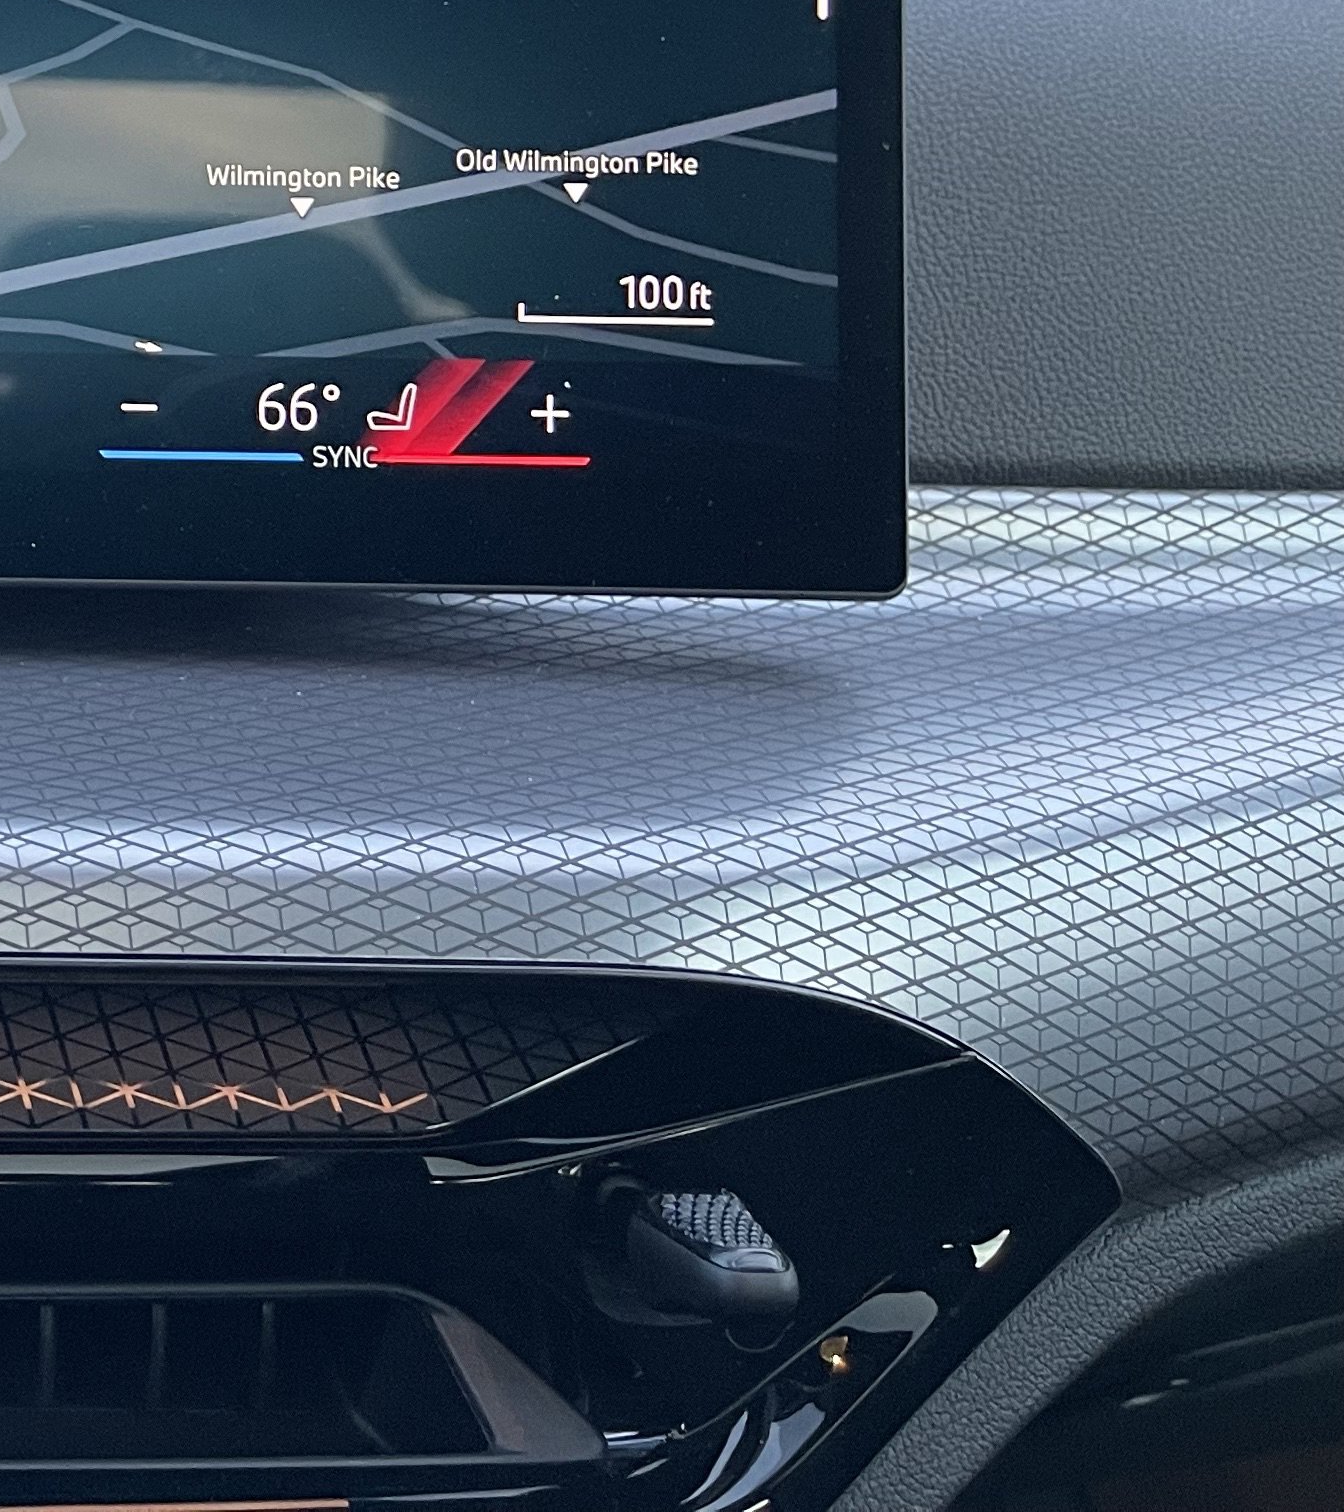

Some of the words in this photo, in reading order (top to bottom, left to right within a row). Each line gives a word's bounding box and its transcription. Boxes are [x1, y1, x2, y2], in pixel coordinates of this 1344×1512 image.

[206, 163, 342, 193] Wilmington
[349, 166, 400, 189] Pike
[454, 148, 500, 174] Old
[502, 148, 641, 181] Wilmington
[645, 150, 700, 177] Pike
[619, 274, 684, 311] 100
[690, 281, 712, 311] ft
[258, 382, 341, 432] 66°
[311, 440, 381, 470] SYNC
